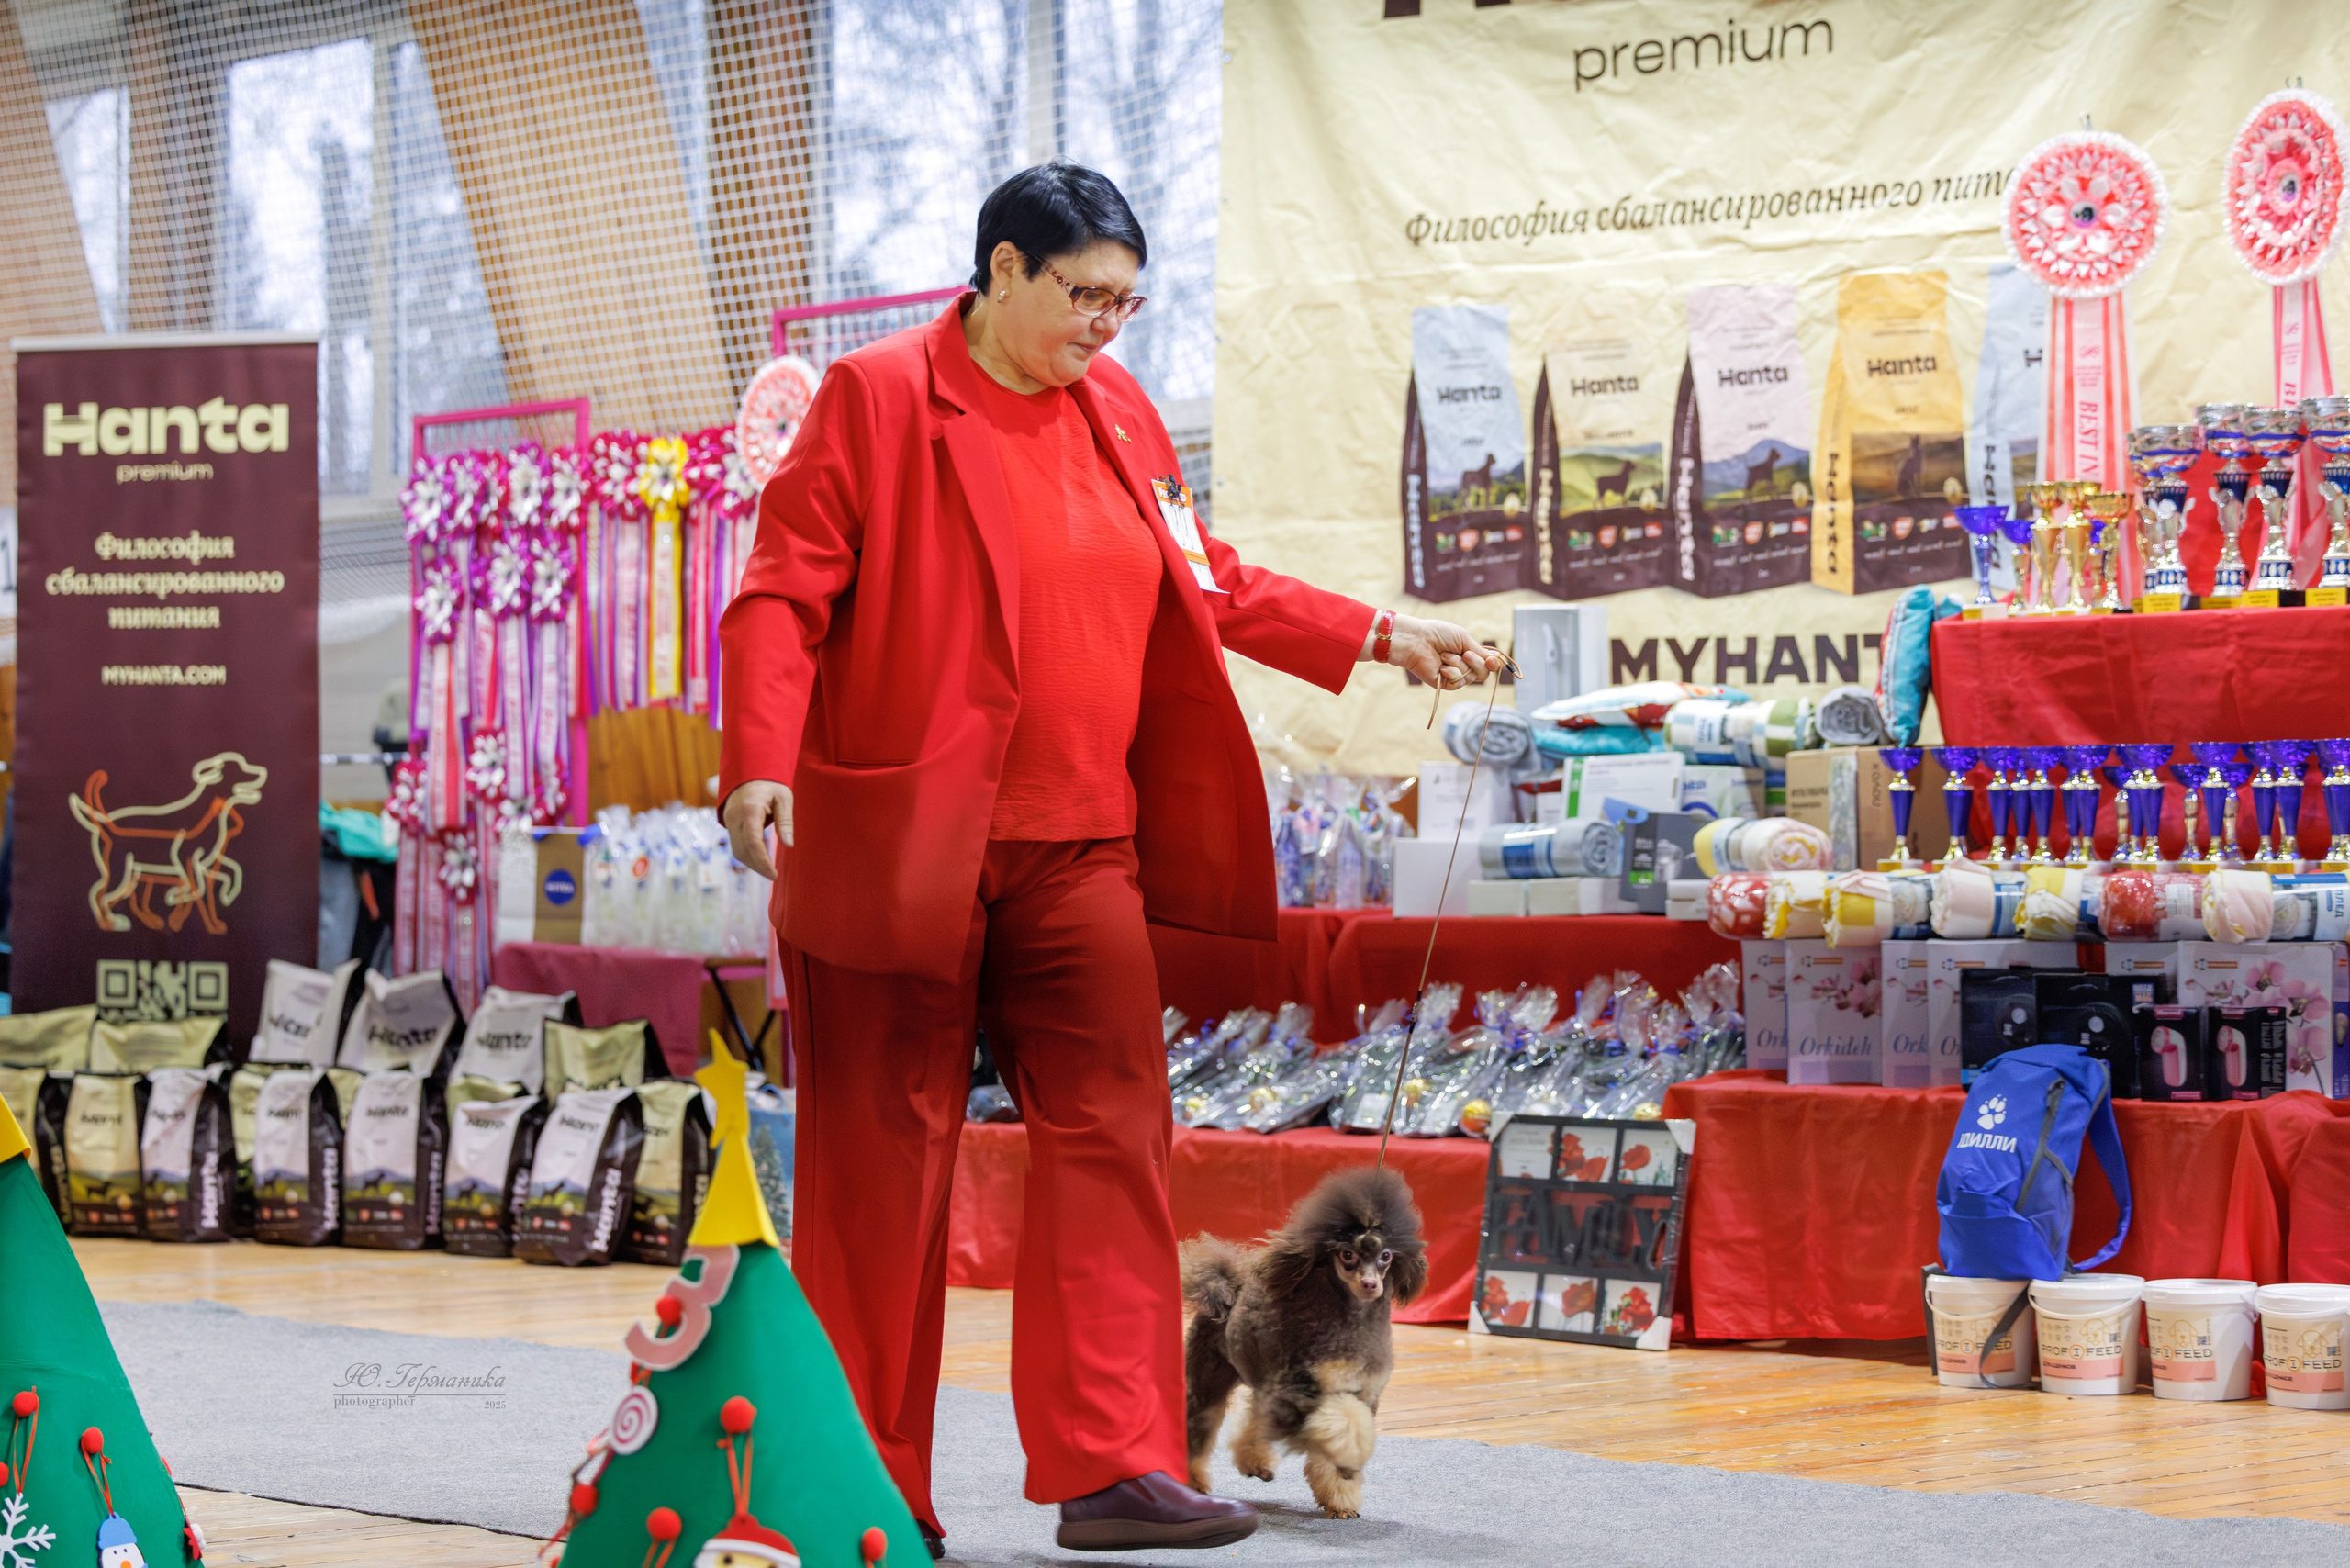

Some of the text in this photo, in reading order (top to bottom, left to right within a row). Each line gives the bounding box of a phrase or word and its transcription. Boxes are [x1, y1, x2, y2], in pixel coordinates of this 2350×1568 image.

[1574, 18, 1833, 91] premium
[1405, 200, 1588, 247] Философия
[1596, 178, 1922, 230] сбалансированного
[1718, 364, 1789, 387] Hanta
[1867, 355, 1937, 377] Hanta
[1437, 385, 1502, 404] Hanta
[1571, 375, 1639, 397] Hanta
[43, 395, 290, 456] Hanta
[2078, 401, 2099, 450] BEST
[116, 460, 214, 485] premium
[95, 529, 236, 566] Философия
[46, 566, 285, 600] сбалансированного
[101, 665, 228, 686] MYHANTA.COM
[1799, 1036, 1872, 1056] Orkideh
